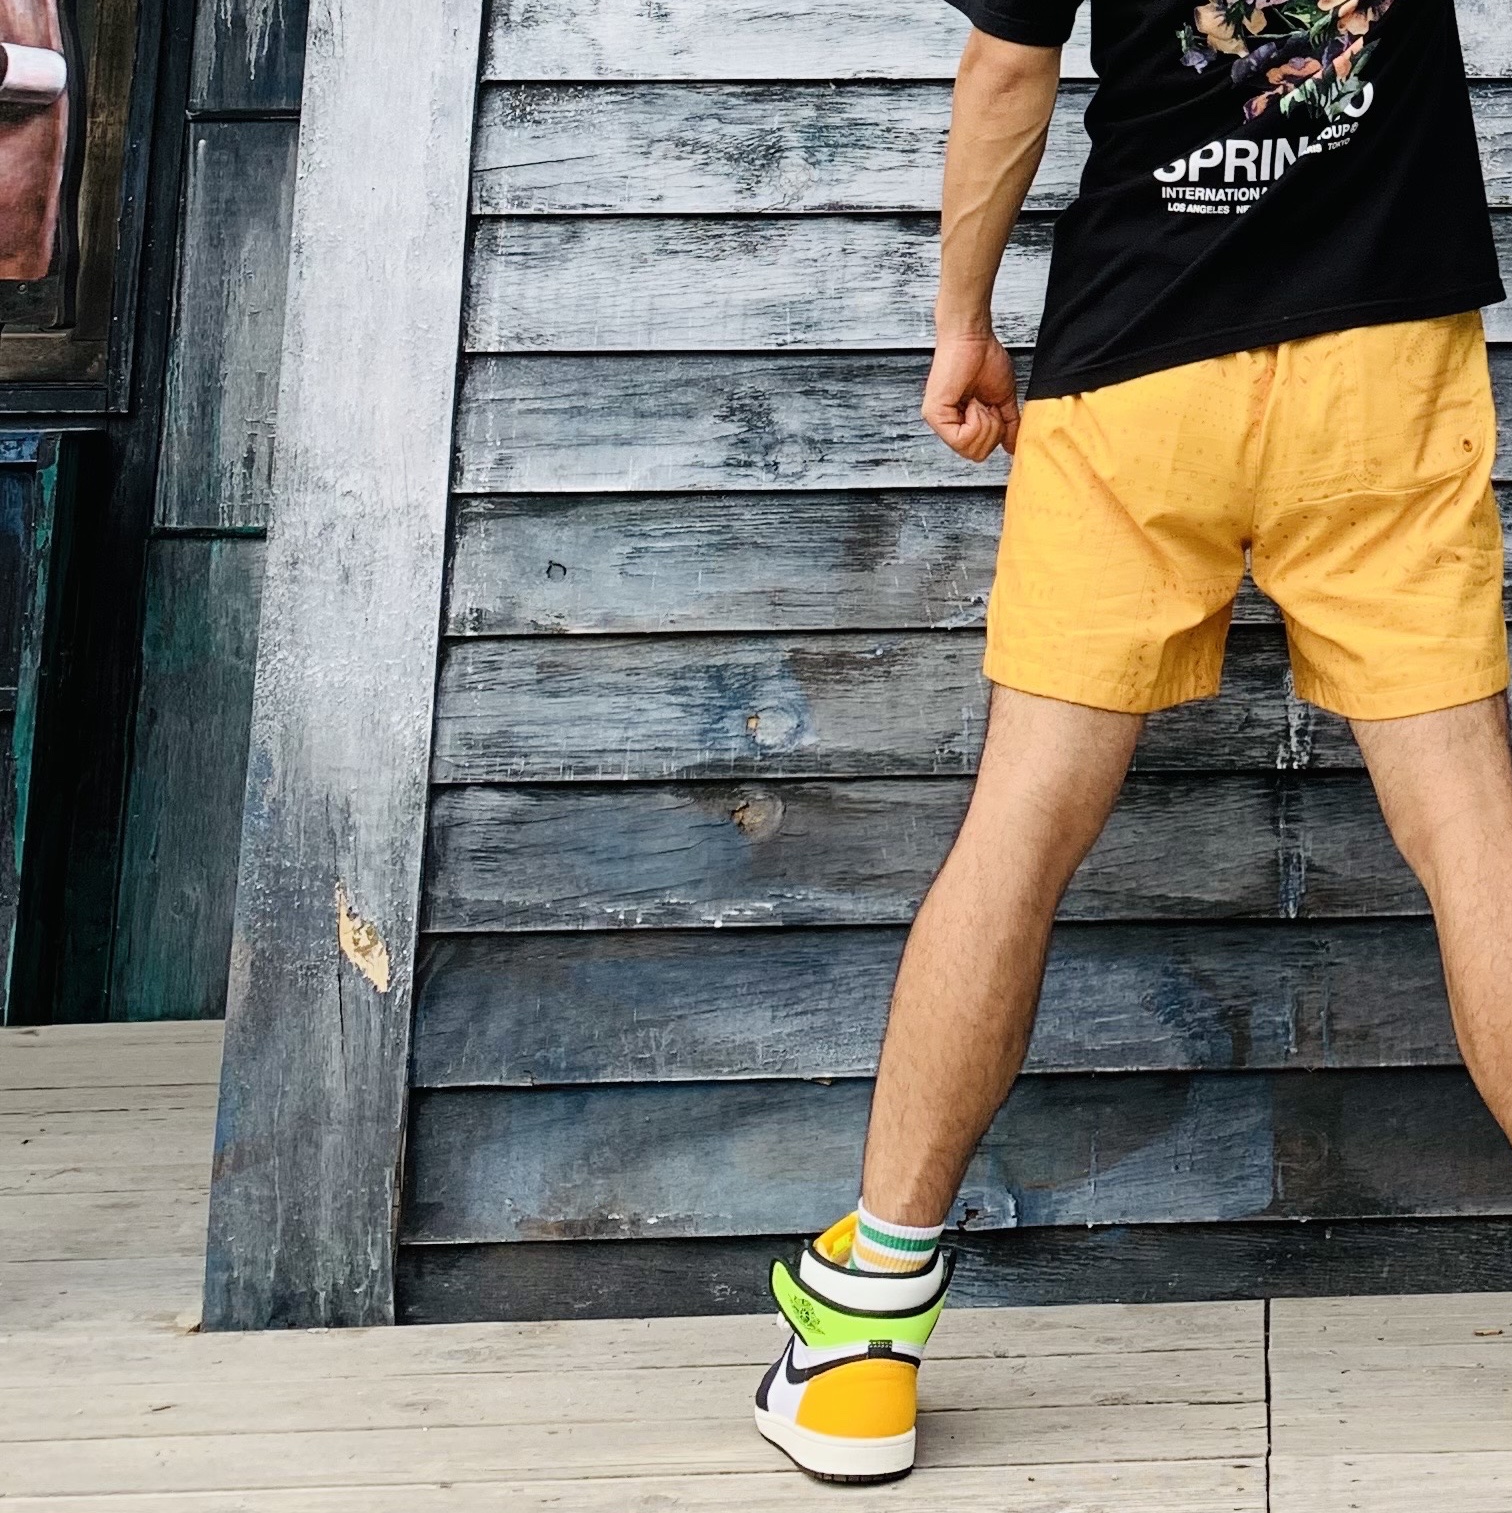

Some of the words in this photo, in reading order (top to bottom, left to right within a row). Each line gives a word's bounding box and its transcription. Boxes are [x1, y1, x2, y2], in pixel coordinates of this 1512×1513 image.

[1153, 137, 1309, 183] SPRIN
[1167, 202, 1186, 213] LOS
[1186, 204, 1230, 214] ANGELES
[1327, 137, 1351, 150] TOKYO
[1161, 186, 1268, 201] INTERNATION
